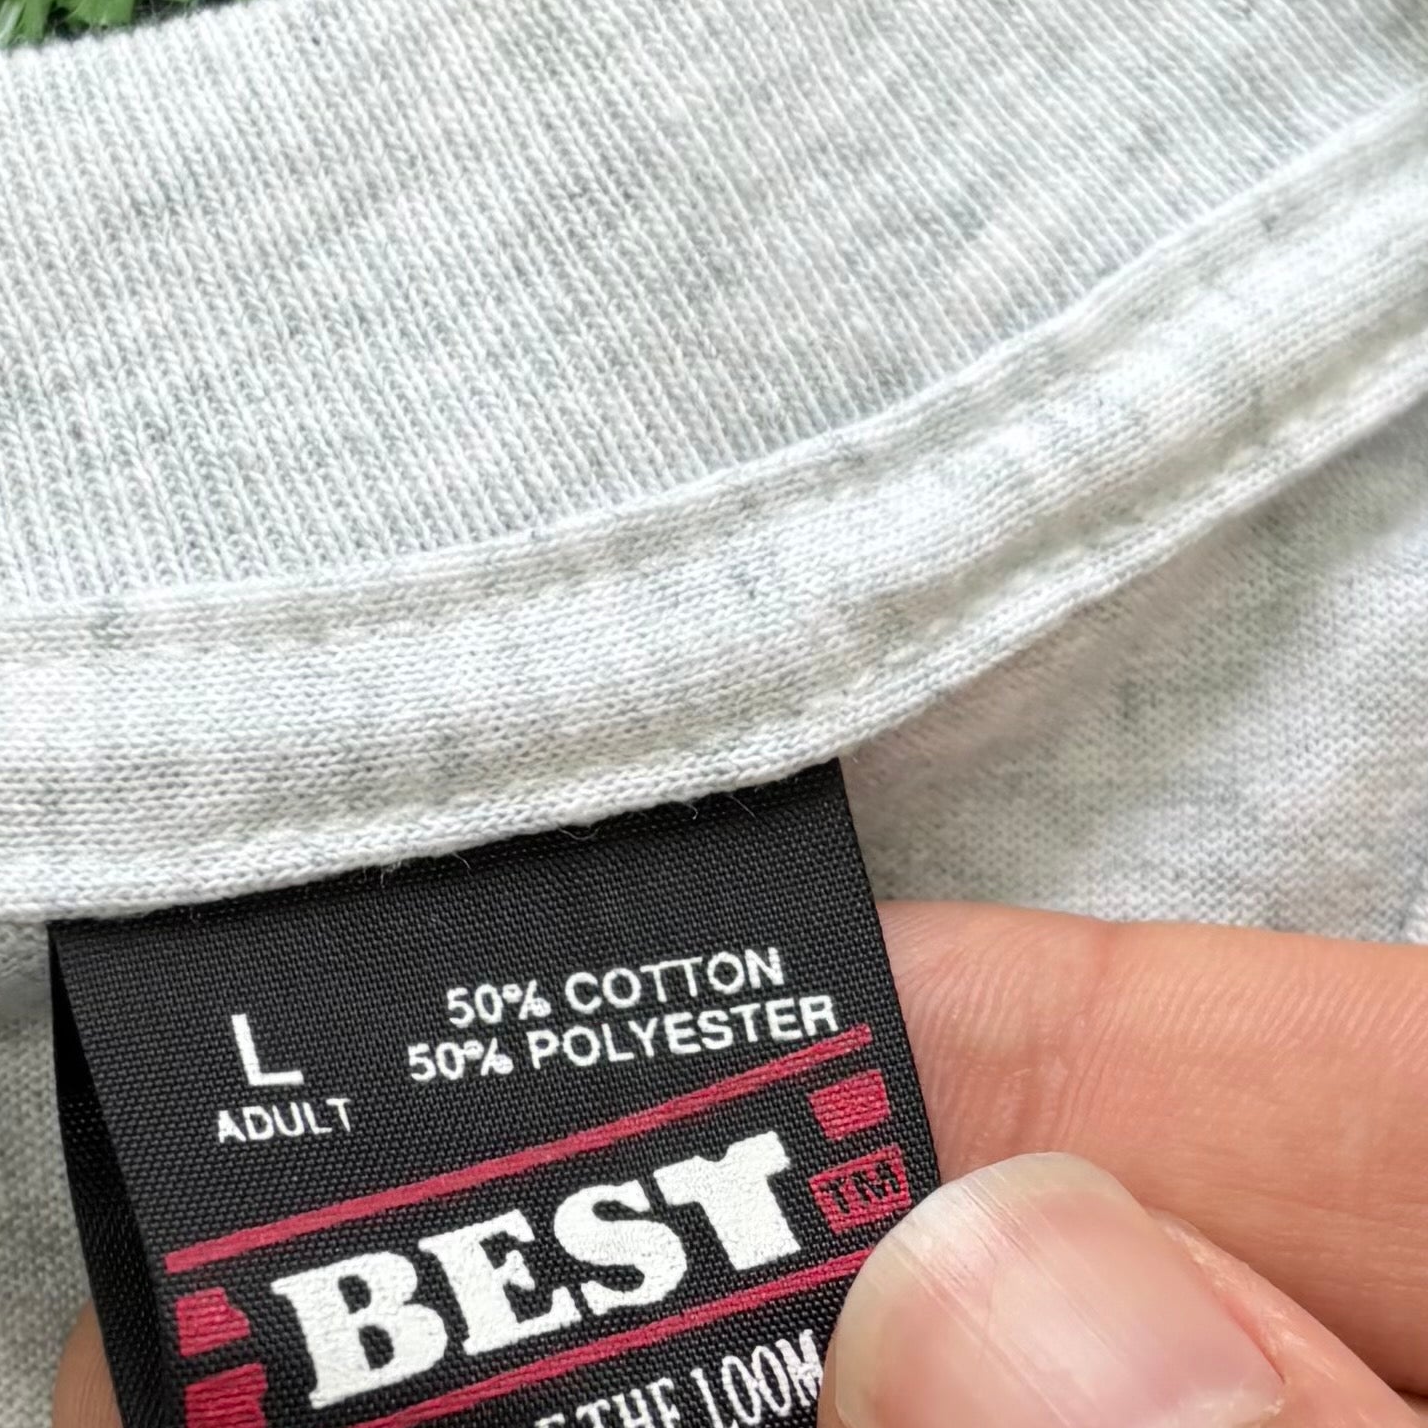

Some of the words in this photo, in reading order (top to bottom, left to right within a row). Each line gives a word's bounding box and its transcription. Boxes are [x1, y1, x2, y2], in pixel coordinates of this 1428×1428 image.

[446, 980, 552, 1028] 50%
[564, 947, 784, 1014] COTTON
[232, 1013, 304, 1088] L
[409, 1035, 514, 1082] 50%
[529, 994, 838, 1069] POLYESTER
[216, 1098, 353, 1145] ADULT
[819, 1161, 901, 1215] TM
[270, 1130, 802, 1410] BEST
